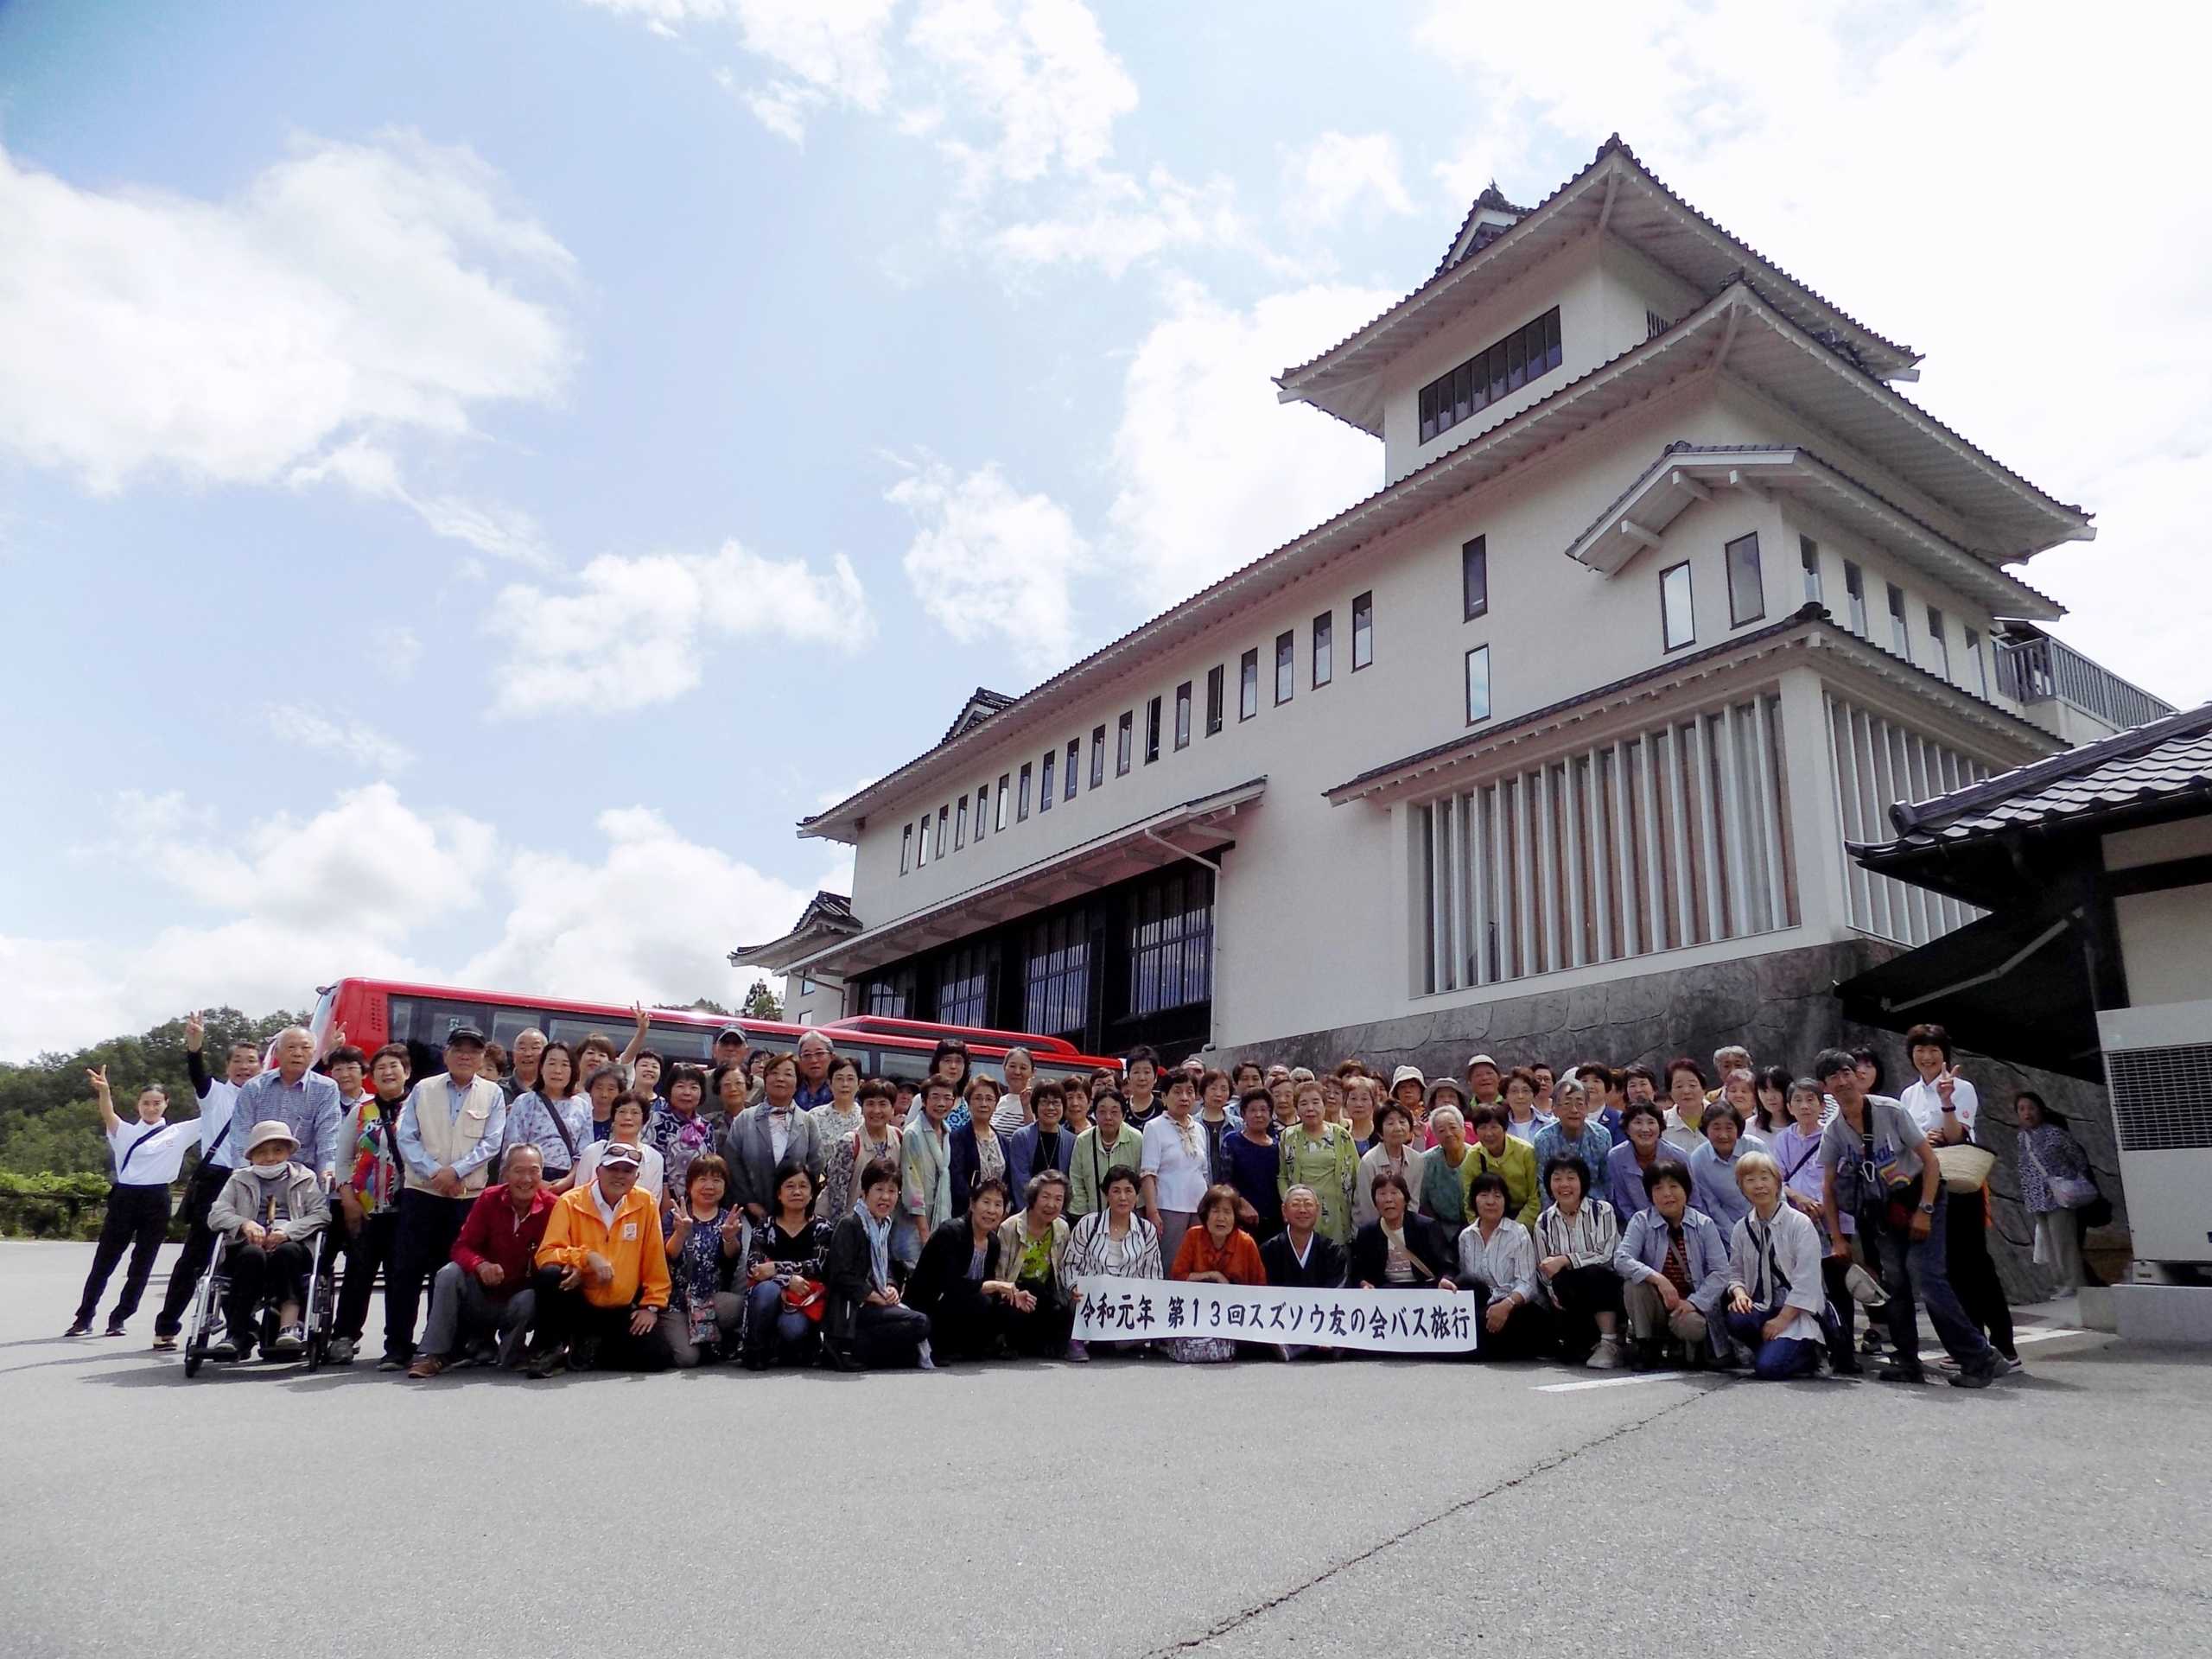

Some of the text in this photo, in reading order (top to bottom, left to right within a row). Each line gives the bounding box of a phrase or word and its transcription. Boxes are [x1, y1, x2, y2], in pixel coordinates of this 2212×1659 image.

[1080, 1292, 1471, 1340] 令和元年 第13回スズソウ友の会バス旅行
